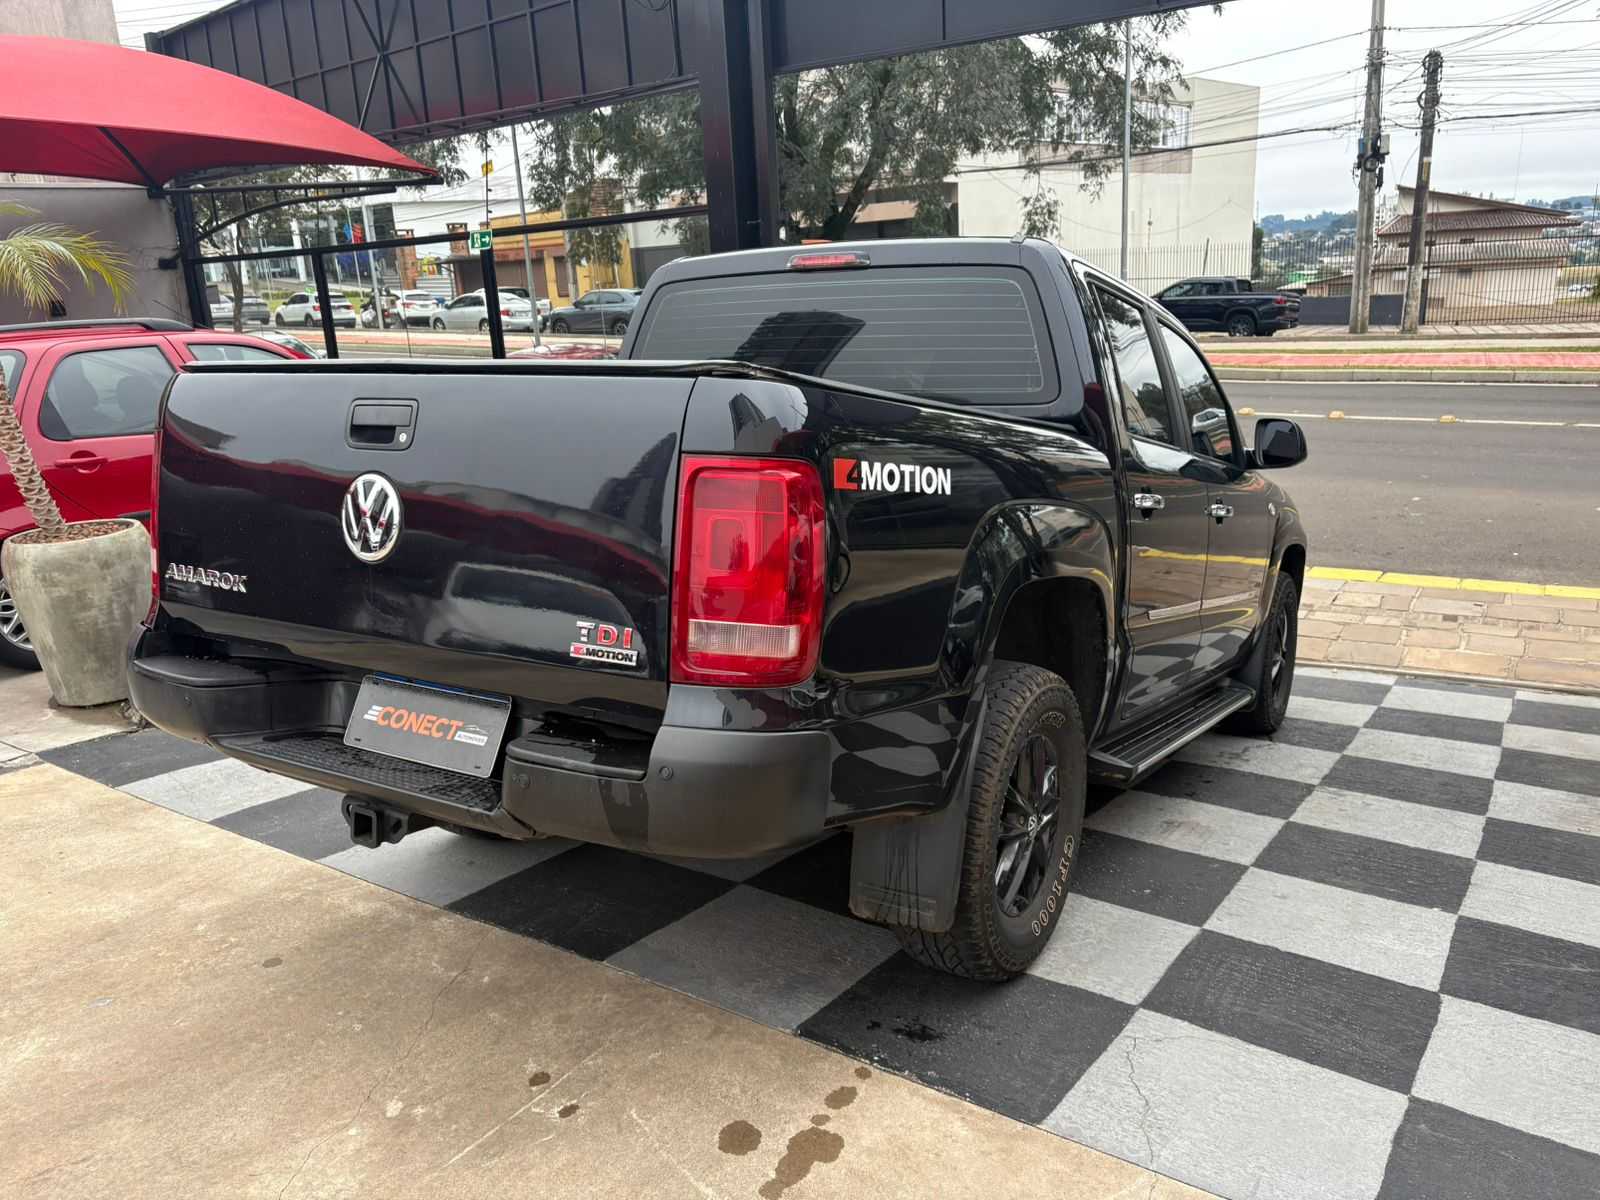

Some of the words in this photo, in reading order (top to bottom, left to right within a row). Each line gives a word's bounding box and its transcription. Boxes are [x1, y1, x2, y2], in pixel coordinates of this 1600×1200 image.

[834, 457, 951, 495] 4MOTION
[165, 562, 247, 593] AMAROK
[576, 621, 632, 649] TDI
[376, 706, 464, 740] CONECT
